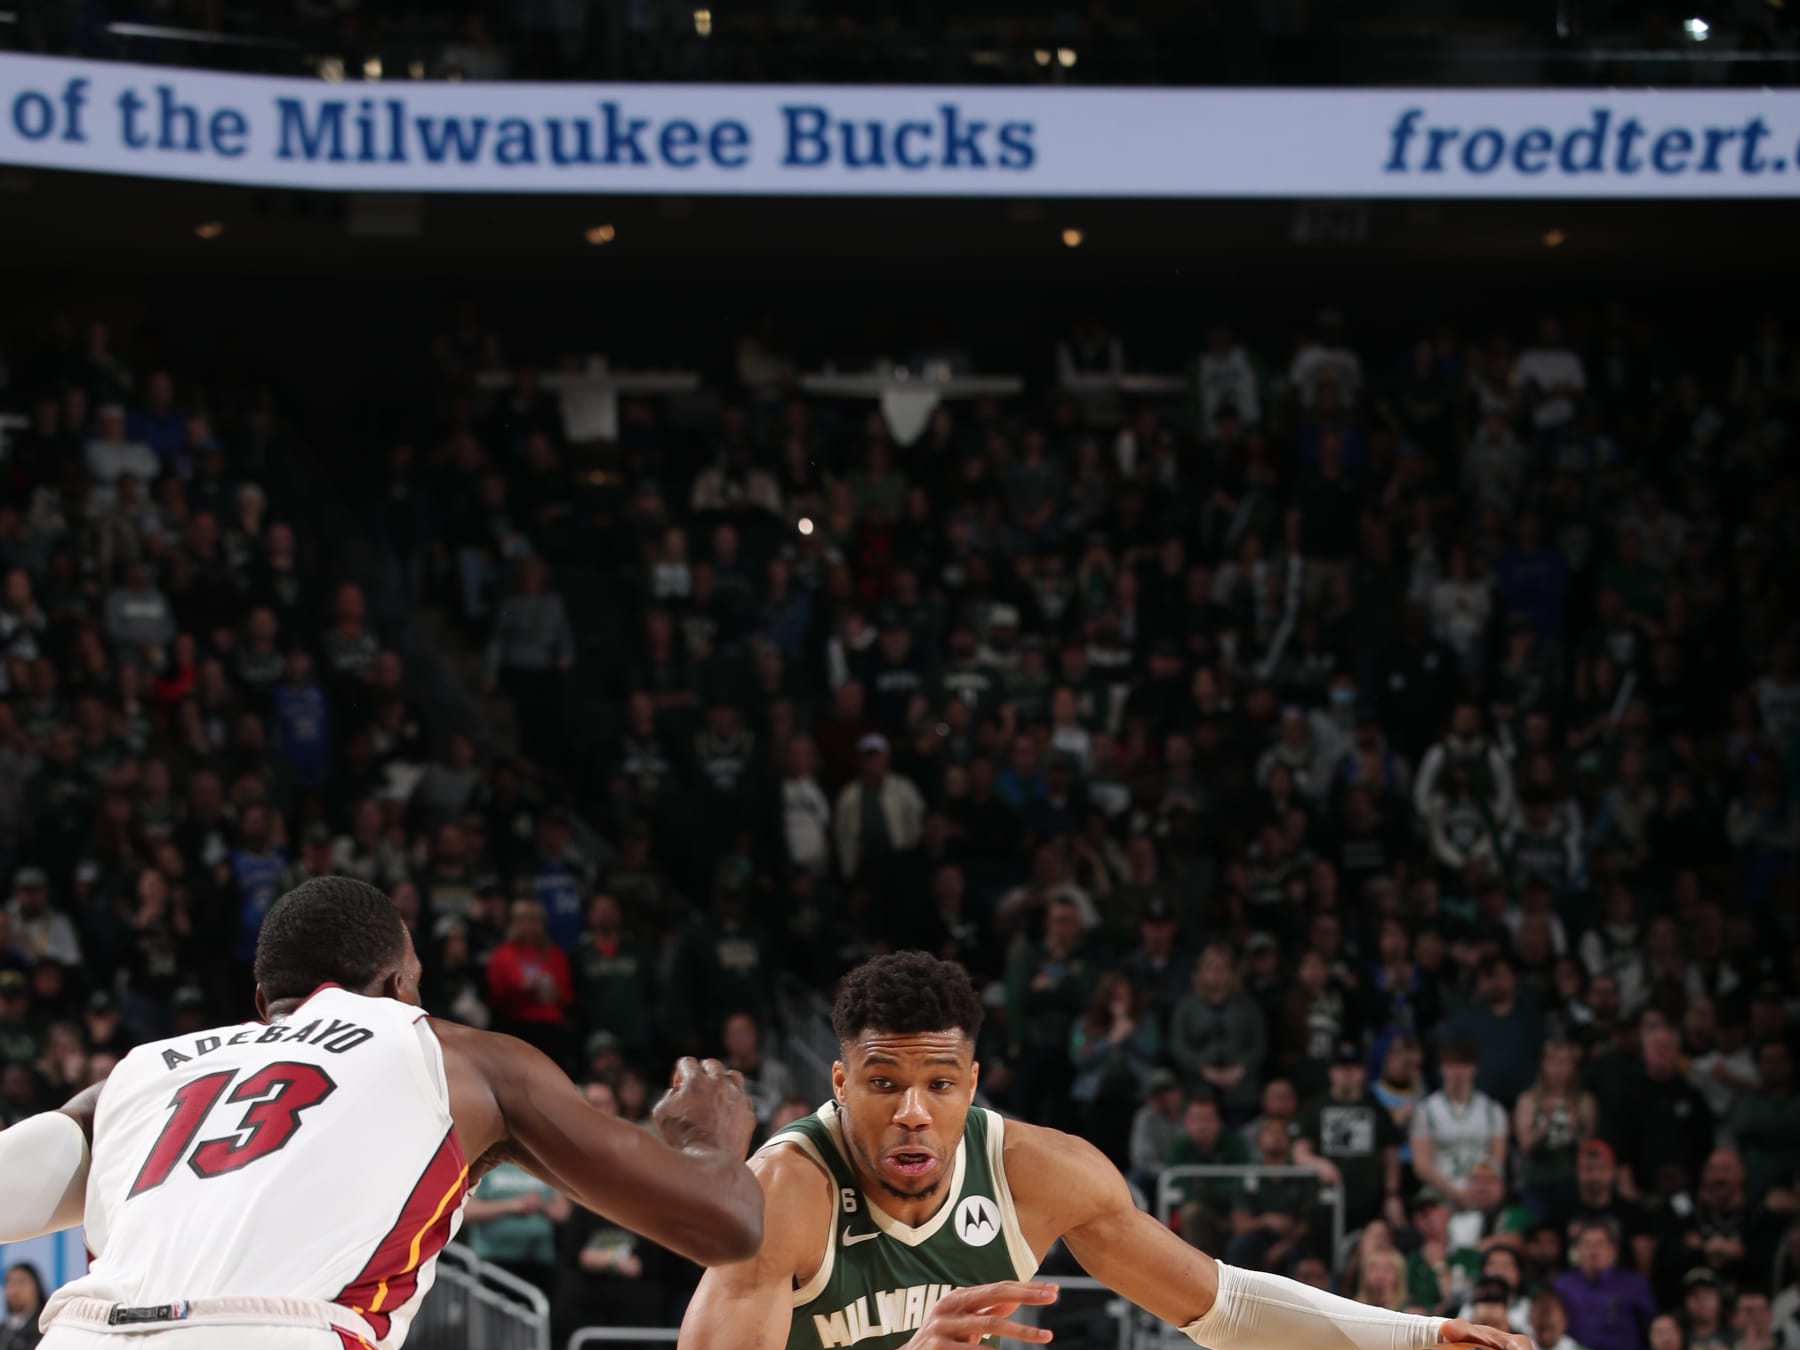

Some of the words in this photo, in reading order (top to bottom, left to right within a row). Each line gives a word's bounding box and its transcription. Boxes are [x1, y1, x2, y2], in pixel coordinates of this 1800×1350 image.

[12, 78, 88, 142] of
[117, 85, 249, 157] the
[275, 97, 749, 169] Milwaukee
[780, 103, 1037, 169] Bucks
[1384, 107, 1800, 174] froedtert.
[161, 1019, 374, 1071] ADEBAYO
[126, 1061, 338, 1200] 13
[841, 1187, 858, 1213] 6
